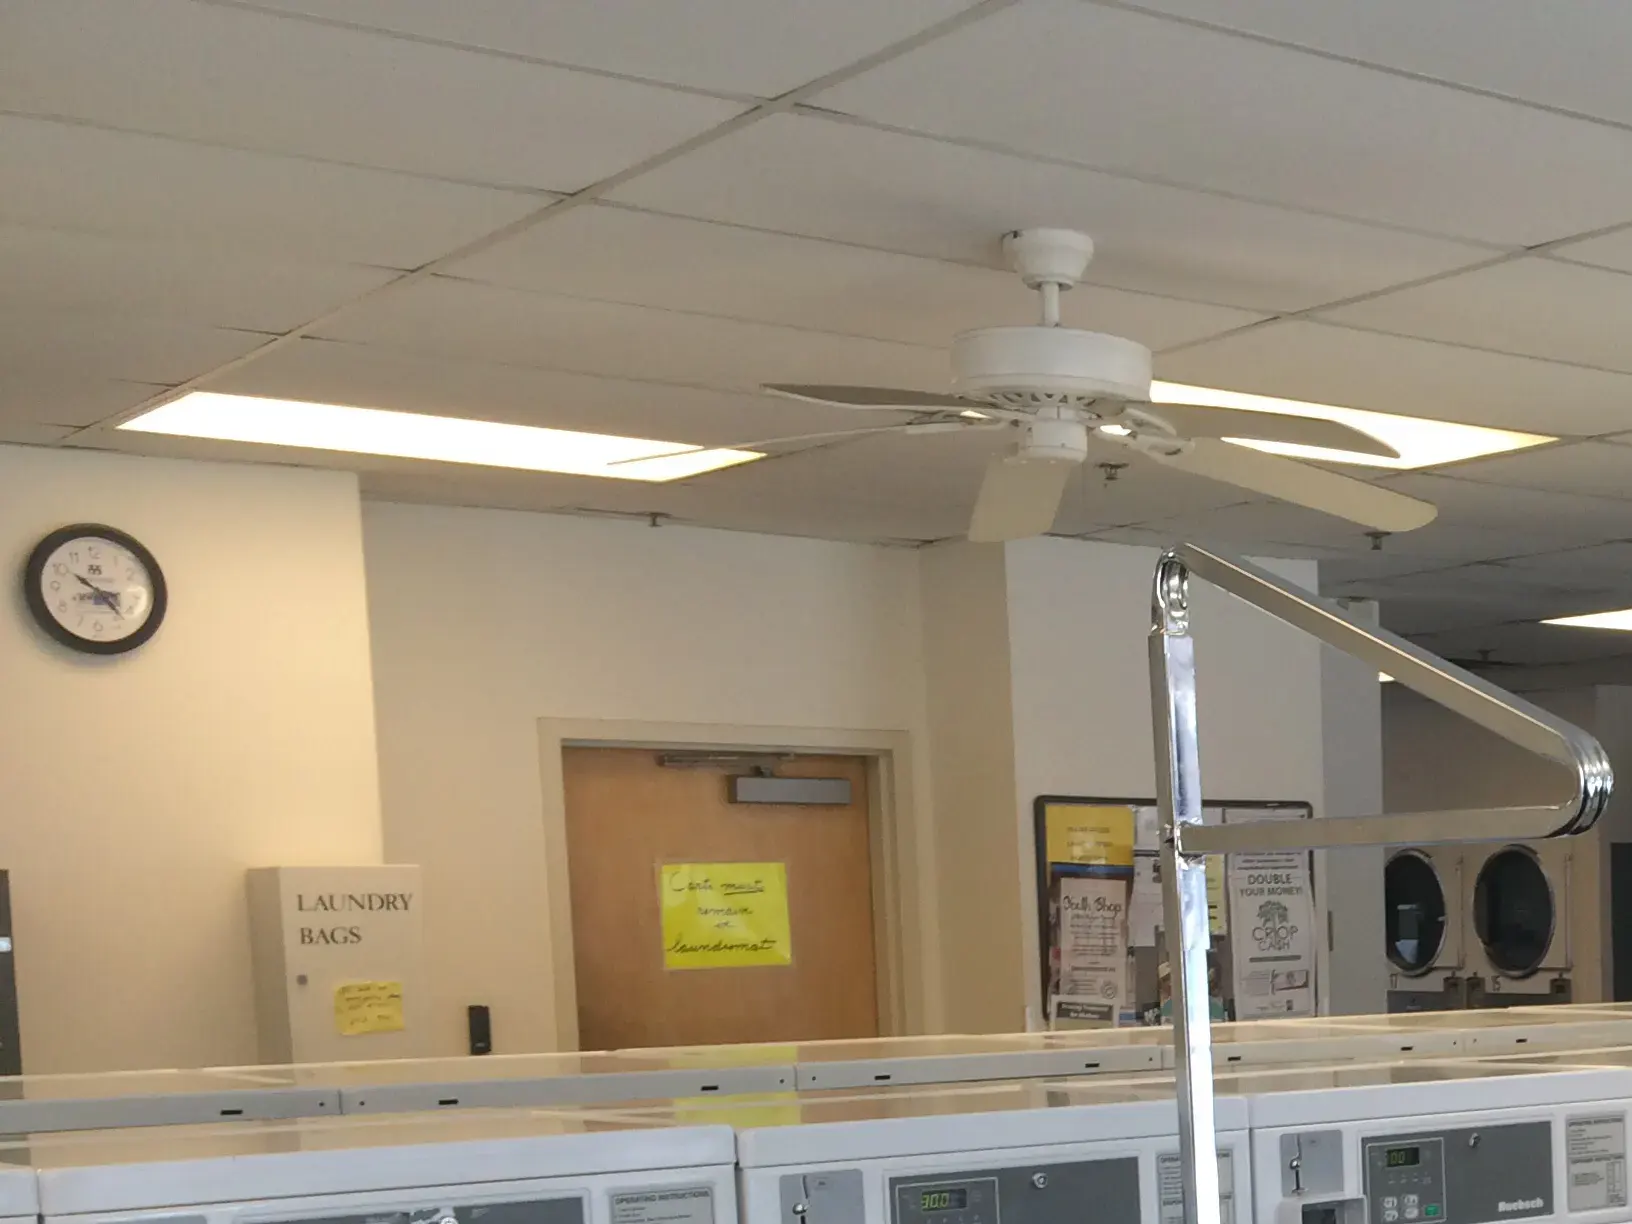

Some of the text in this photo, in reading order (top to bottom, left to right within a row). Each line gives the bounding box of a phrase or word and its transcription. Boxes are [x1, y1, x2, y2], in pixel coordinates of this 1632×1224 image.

[1248, 874, 1293, 885] DOUBLE
[1239, 886, 1266, 897] YOUR
[297, 891, 413, 912] LAUNDRY
[300, 926, 362, 945] BAGS
